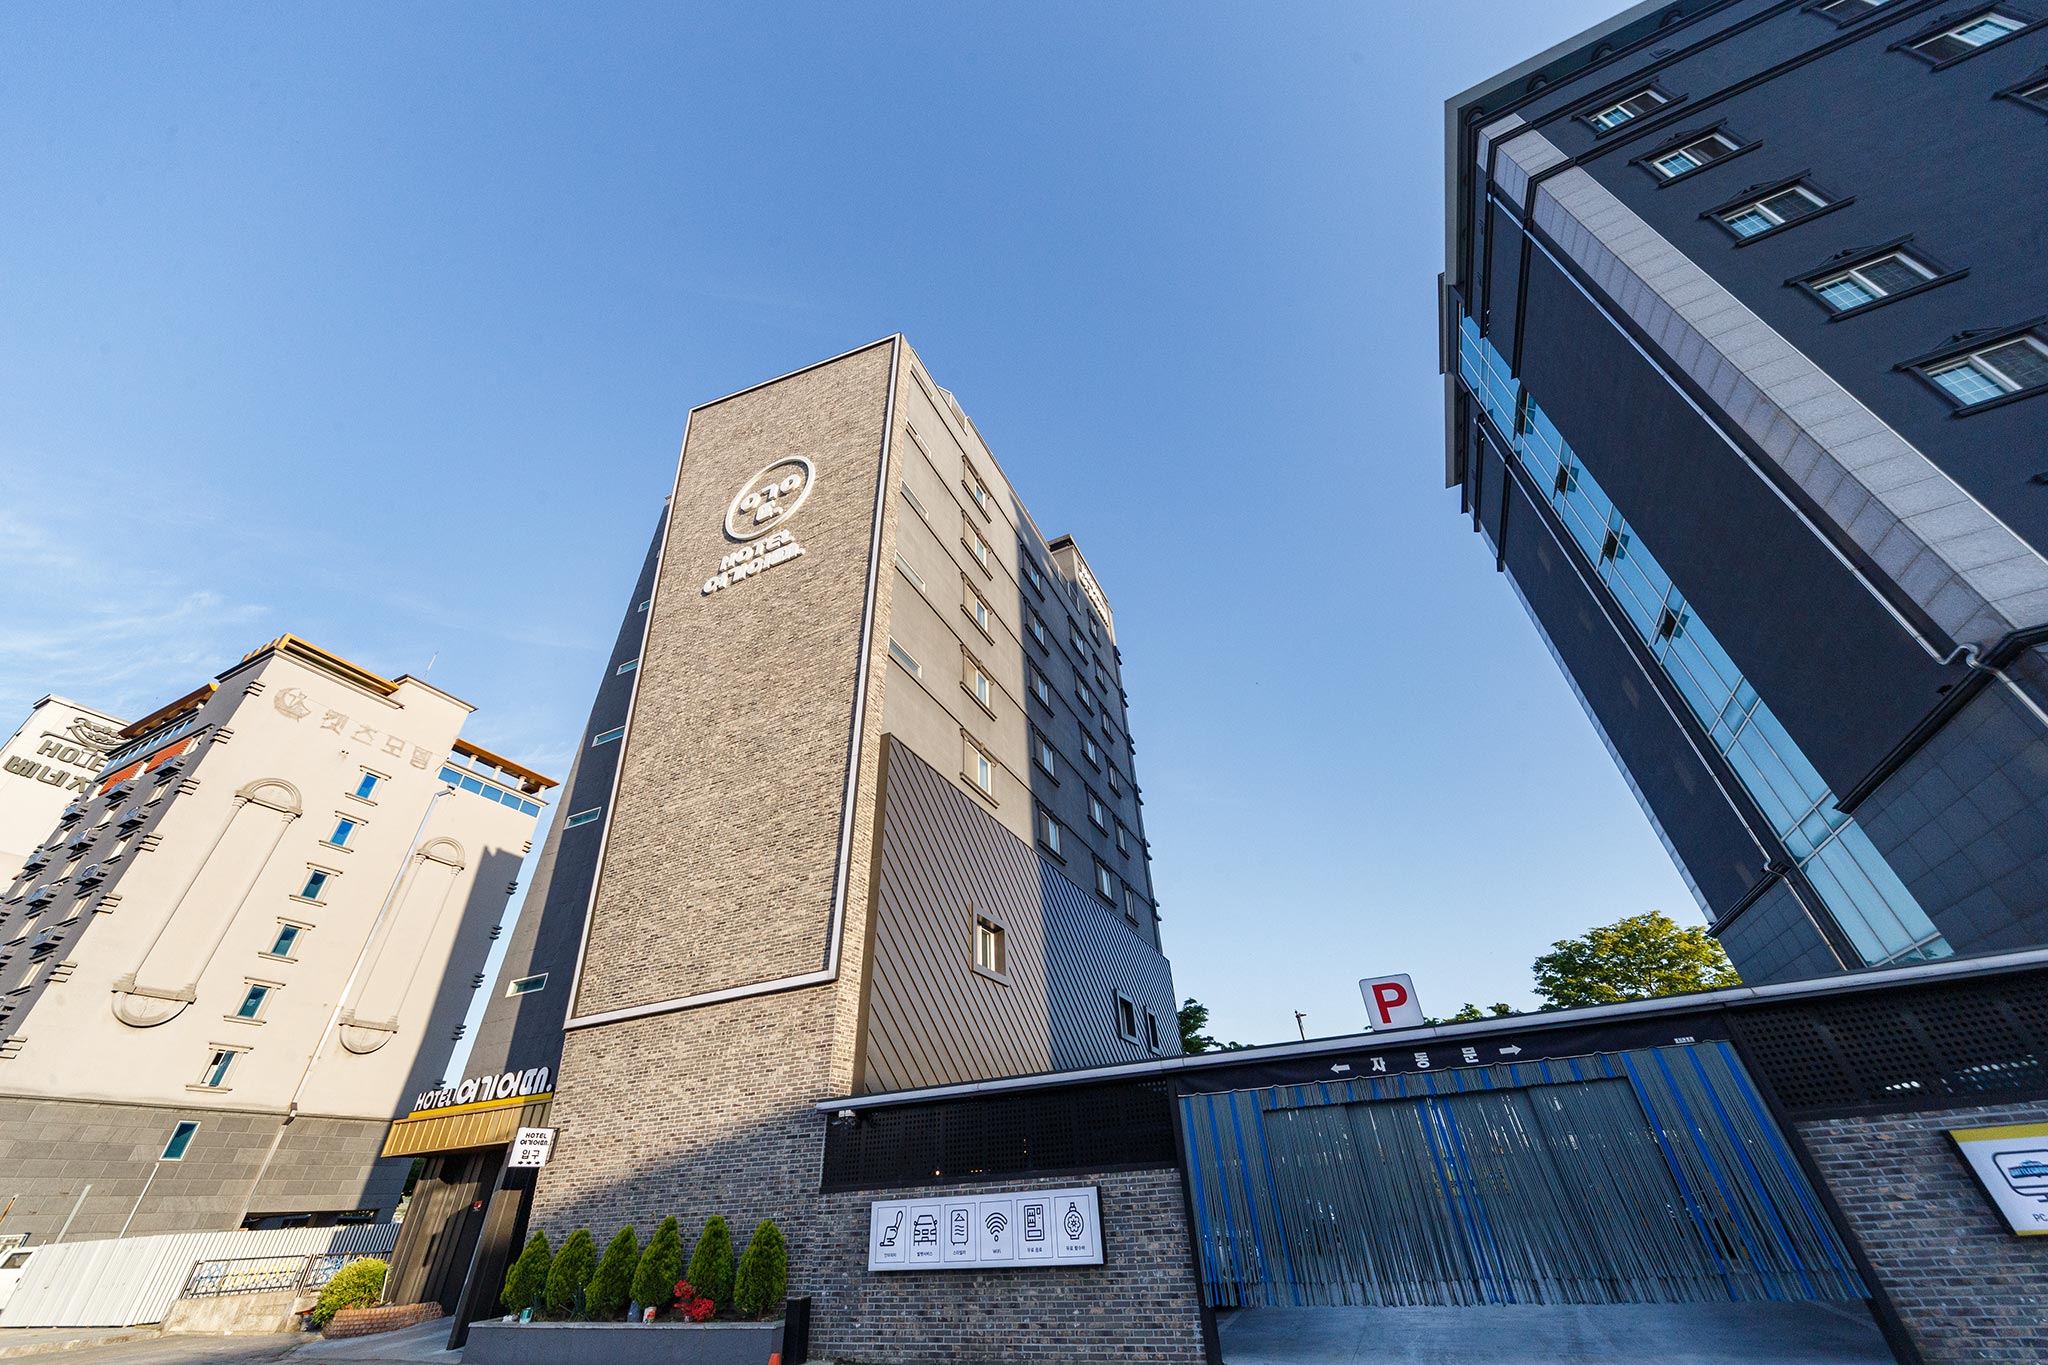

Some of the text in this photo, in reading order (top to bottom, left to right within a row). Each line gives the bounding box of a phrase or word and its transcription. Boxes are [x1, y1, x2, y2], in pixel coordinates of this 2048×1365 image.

[1371, 982, 1409, 1025] P
[413, 1089, 452, 1112] HOTEL
[525, 1132, 547, 1140] HOTEL
[521, 1149, 540, 1160] 입구
